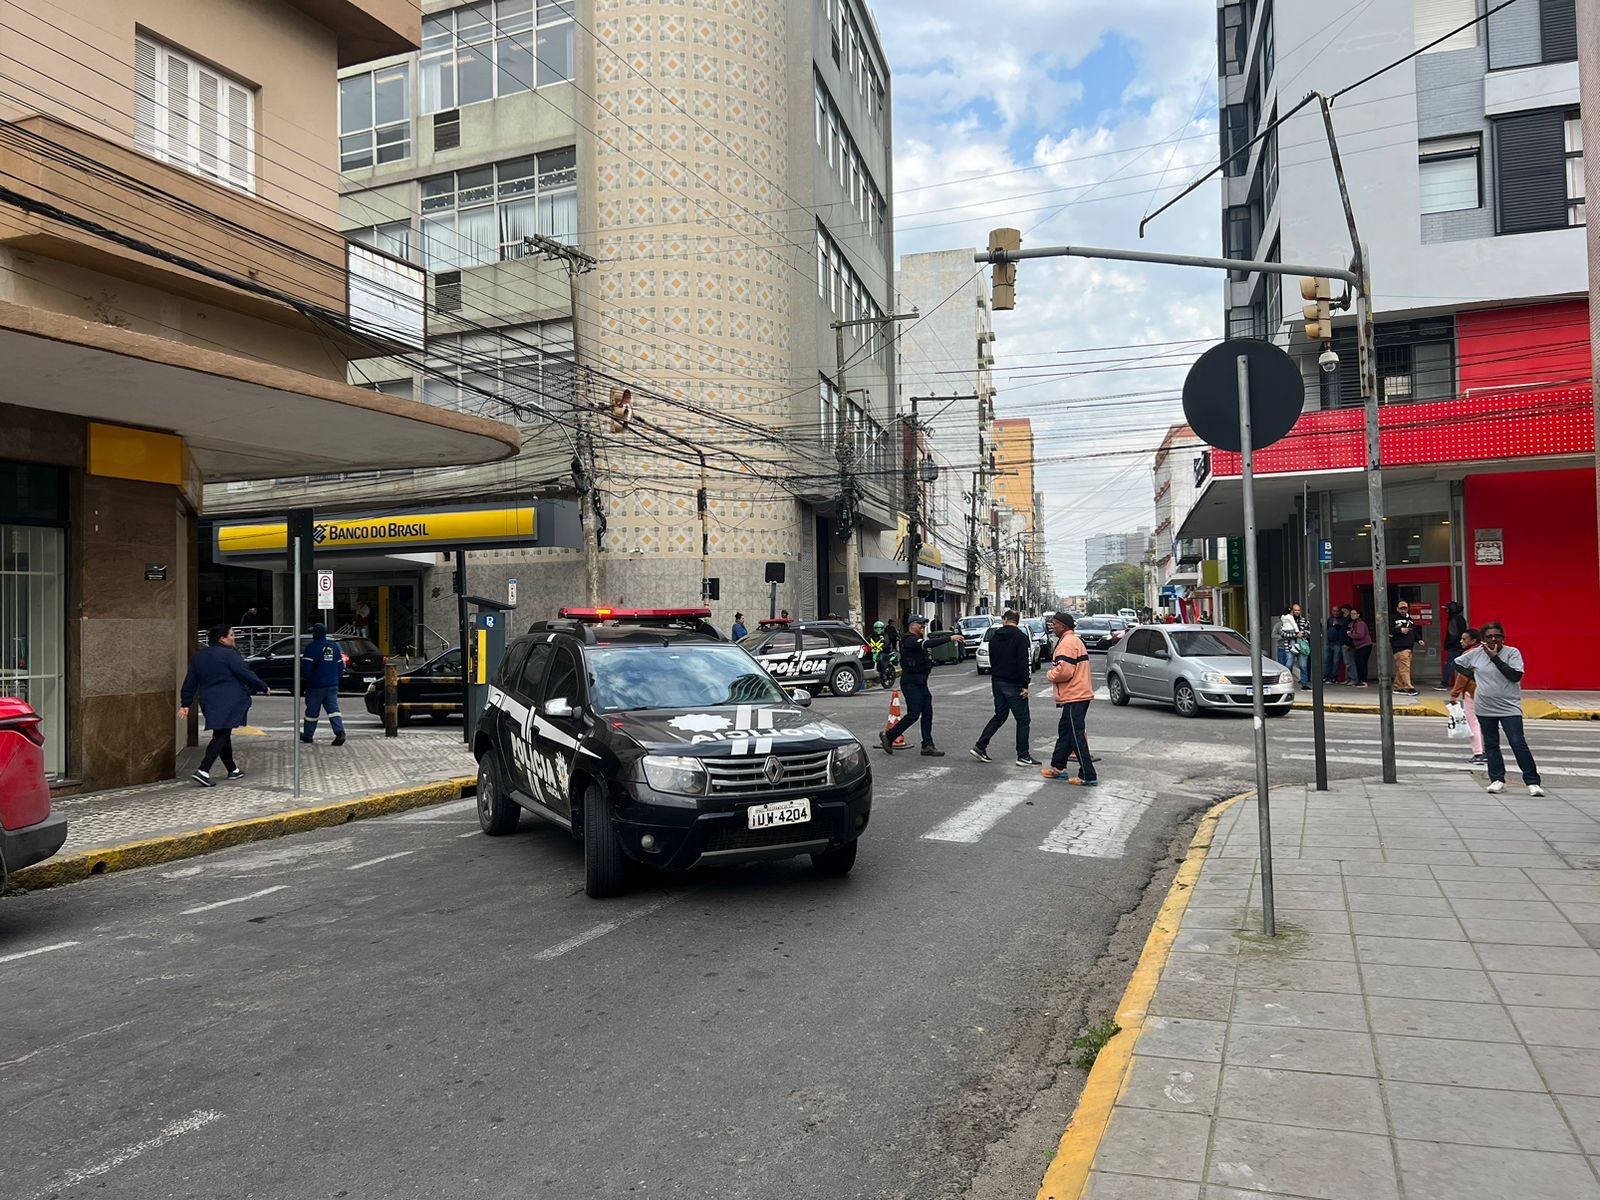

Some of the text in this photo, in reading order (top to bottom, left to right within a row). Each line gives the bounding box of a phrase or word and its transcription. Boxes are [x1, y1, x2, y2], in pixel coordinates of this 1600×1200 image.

[329, 522, 429, 540] BANCO DO BRASIL
